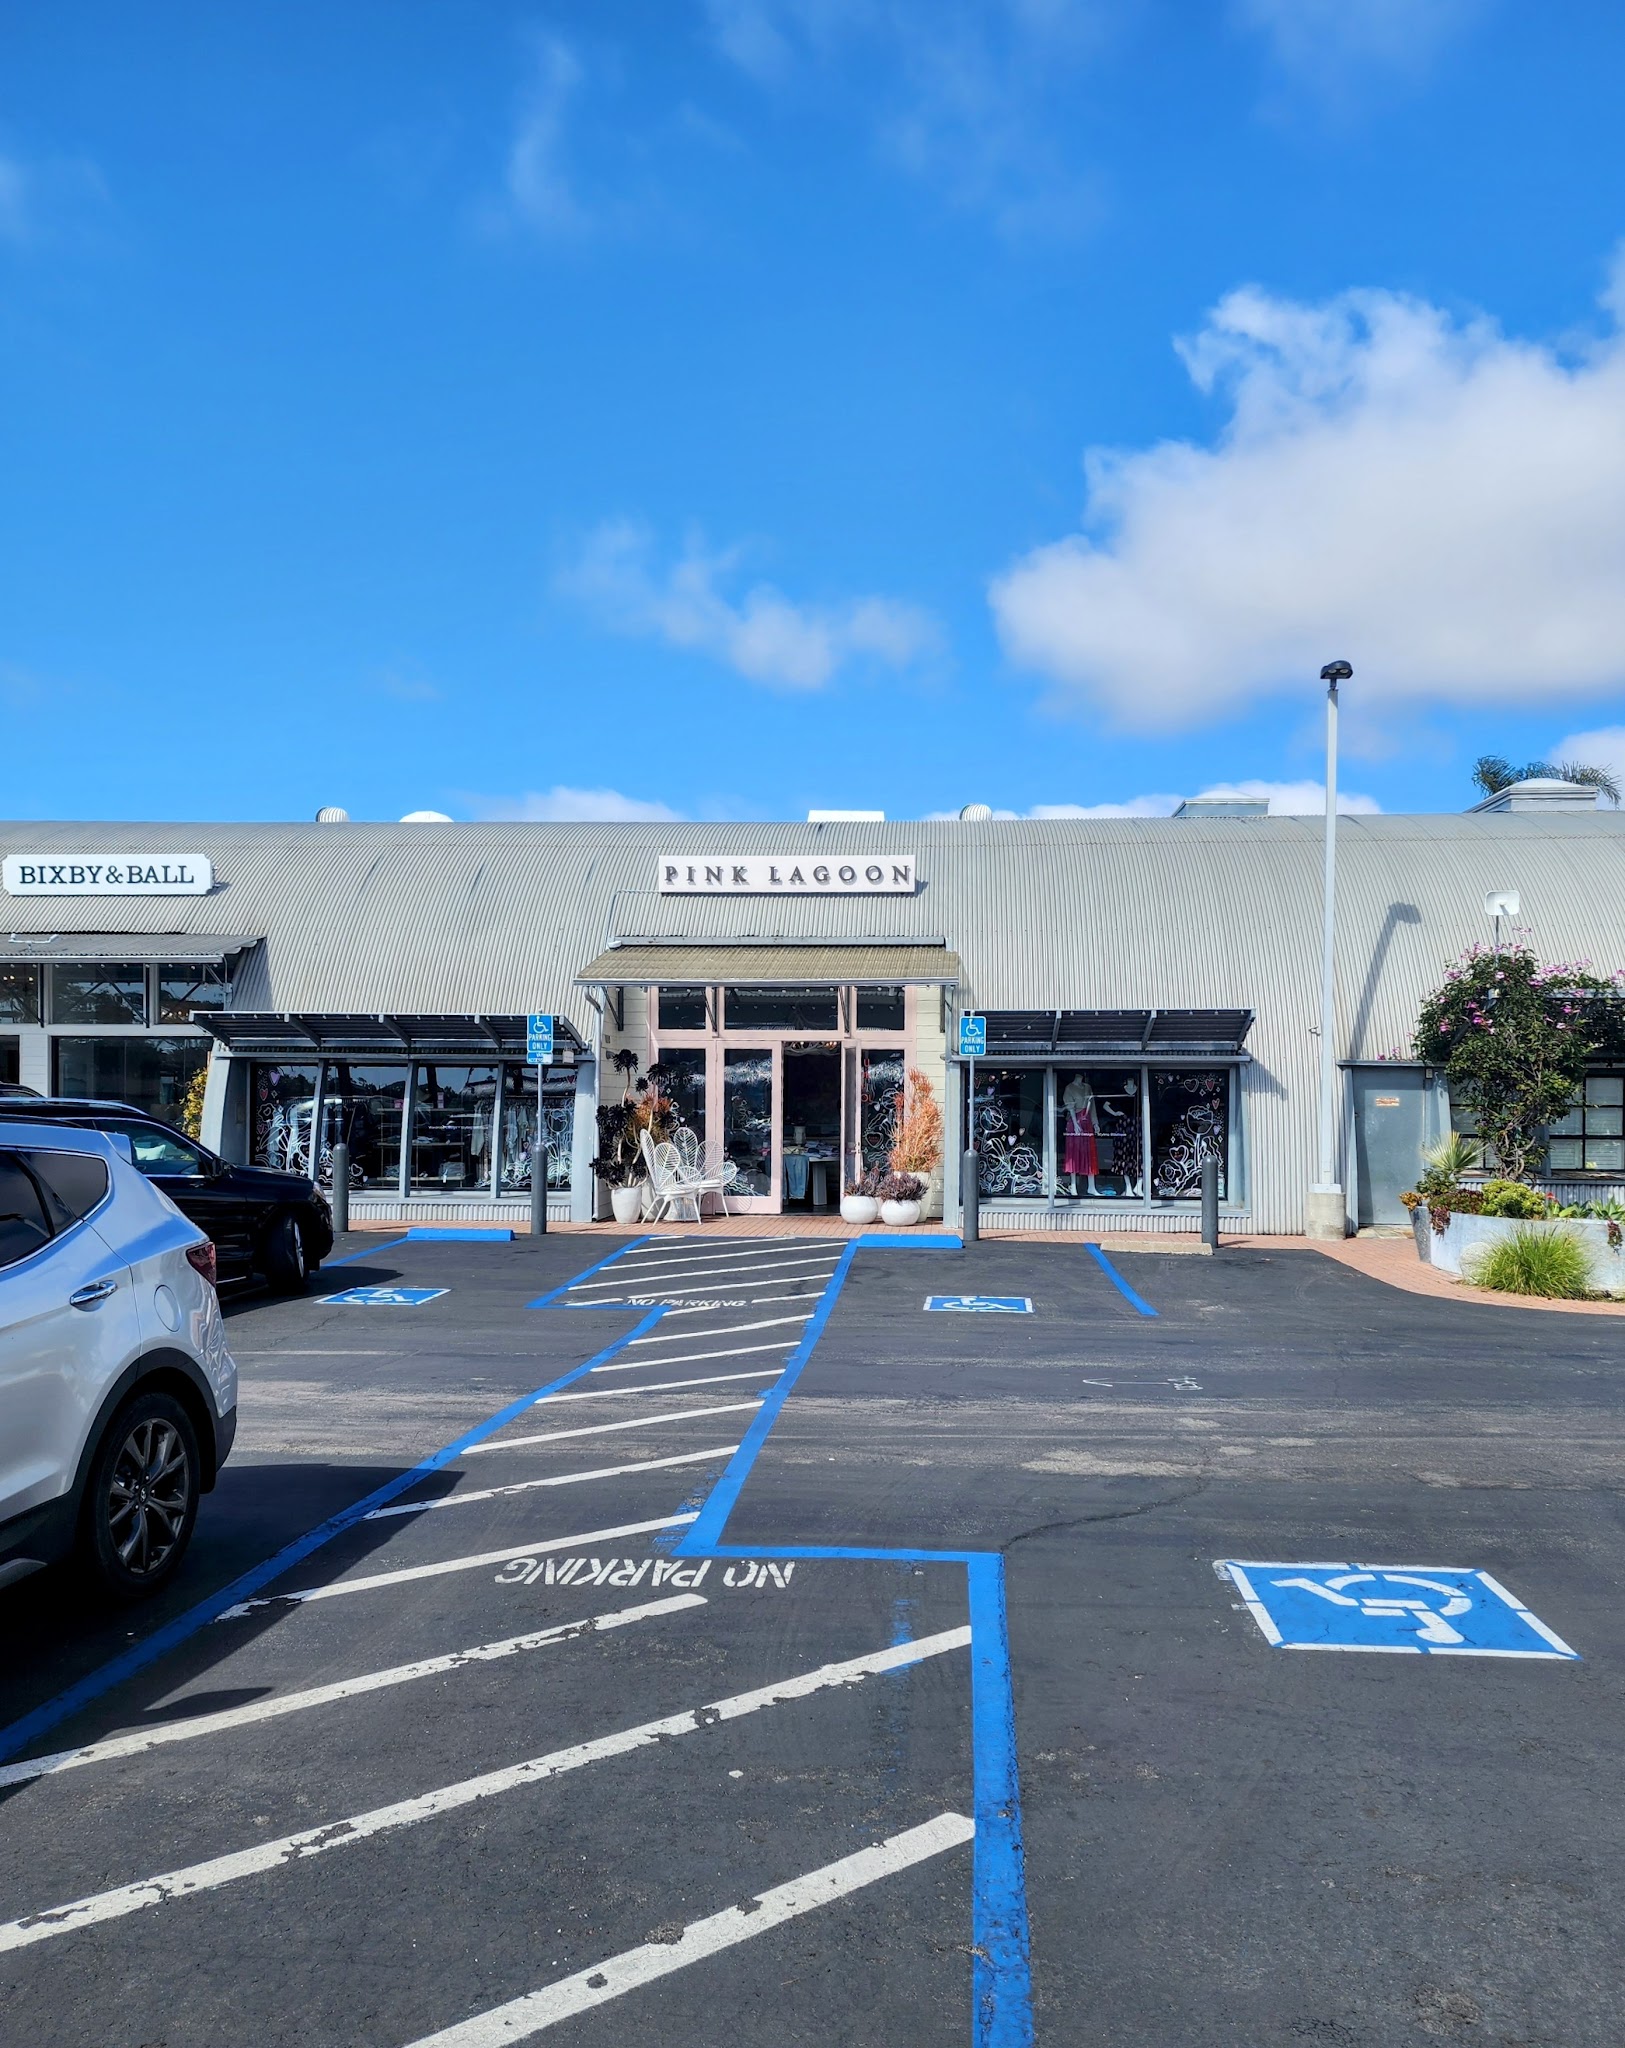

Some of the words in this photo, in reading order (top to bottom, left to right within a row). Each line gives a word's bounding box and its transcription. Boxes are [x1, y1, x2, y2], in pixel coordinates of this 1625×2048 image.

[664, 866, 748, 883] PINK
[768, 866, 912, 883] LAGOON
[529, 1033, 551, 1041] PARKING
[961, 1036, 984, 1044] PARKING
[532, 1042, 548, 1050] ONLY
[964, 1045, 980, 1053] ONLY
[626, 1298, 656, 1306] NO
[659, 1299, 747, 1307] PARKING
[494, 1558, 712, 1588] PARKING
[722, 1560, 796, 1588] NO
